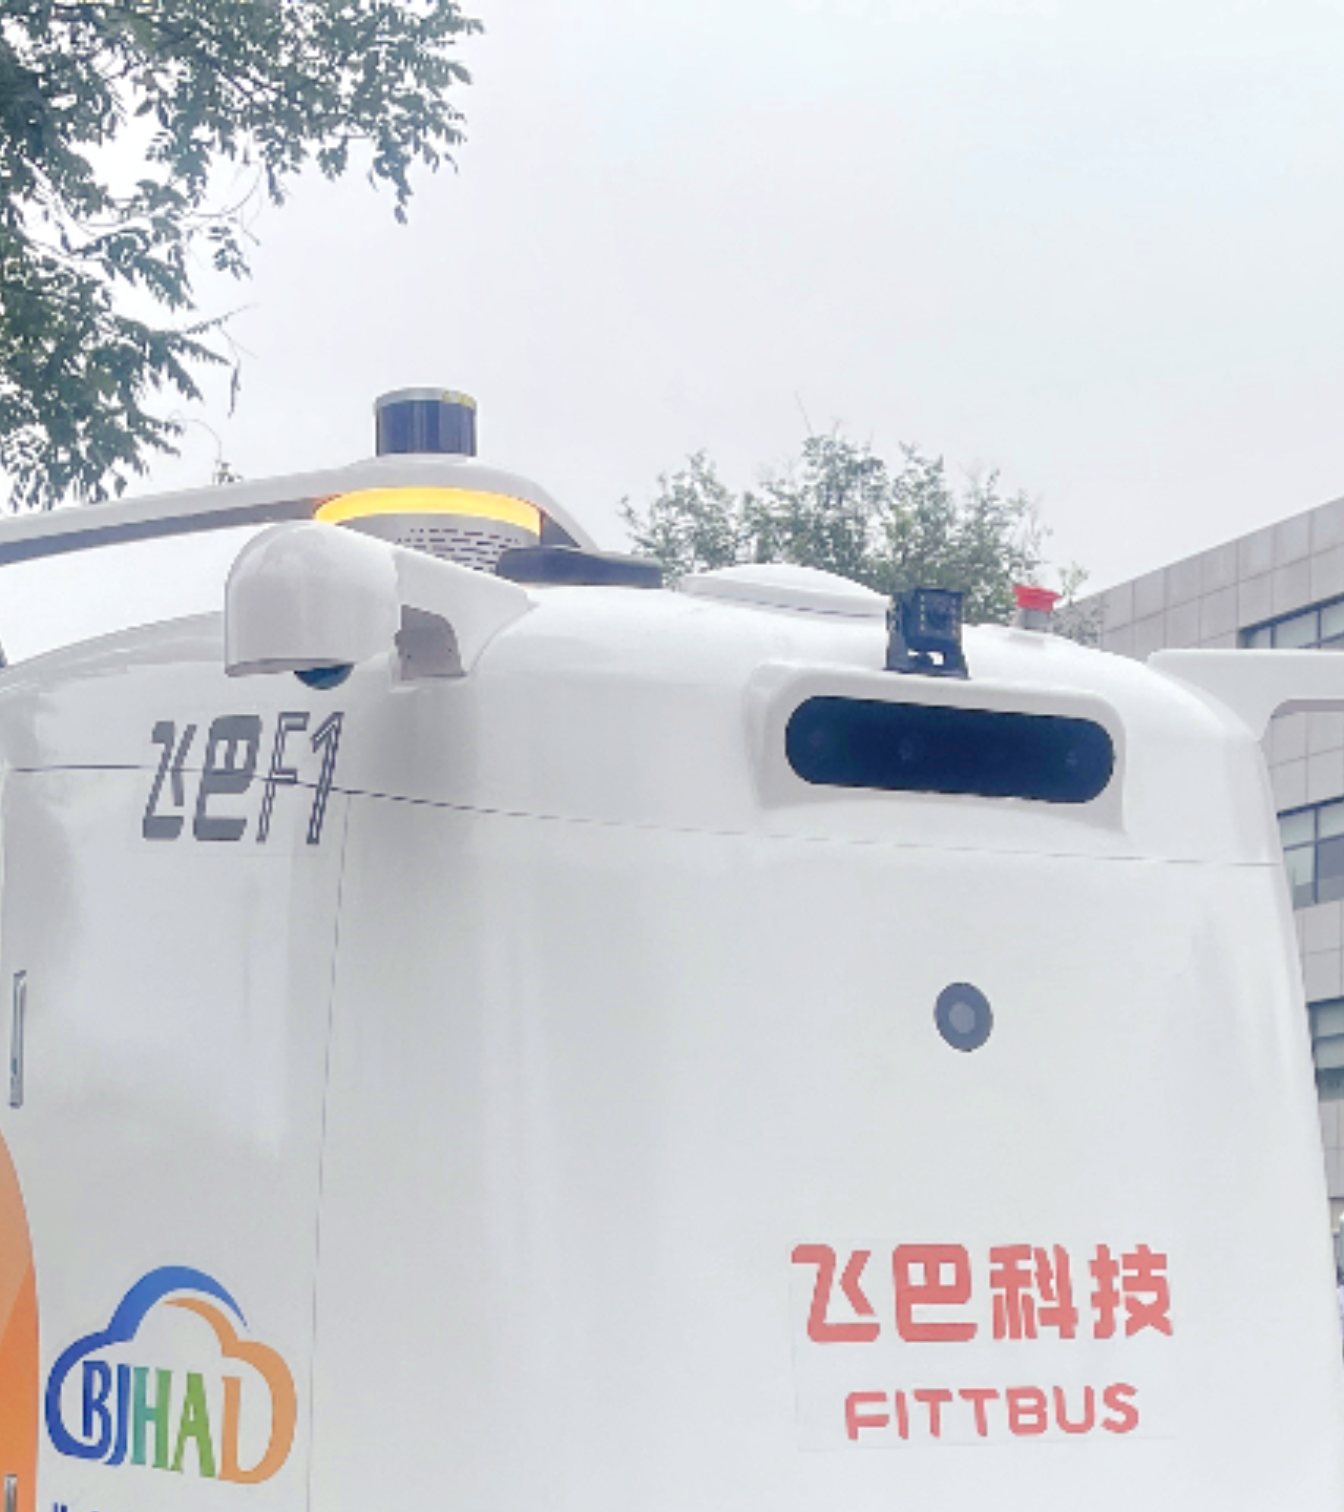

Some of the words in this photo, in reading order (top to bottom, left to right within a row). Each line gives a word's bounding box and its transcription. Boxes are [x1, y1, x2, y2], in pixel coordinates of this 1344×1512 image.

[791, 1243, 1174, 1343] 飞巴科技
[844, 1383, 1140, 1440] FITTBUS
